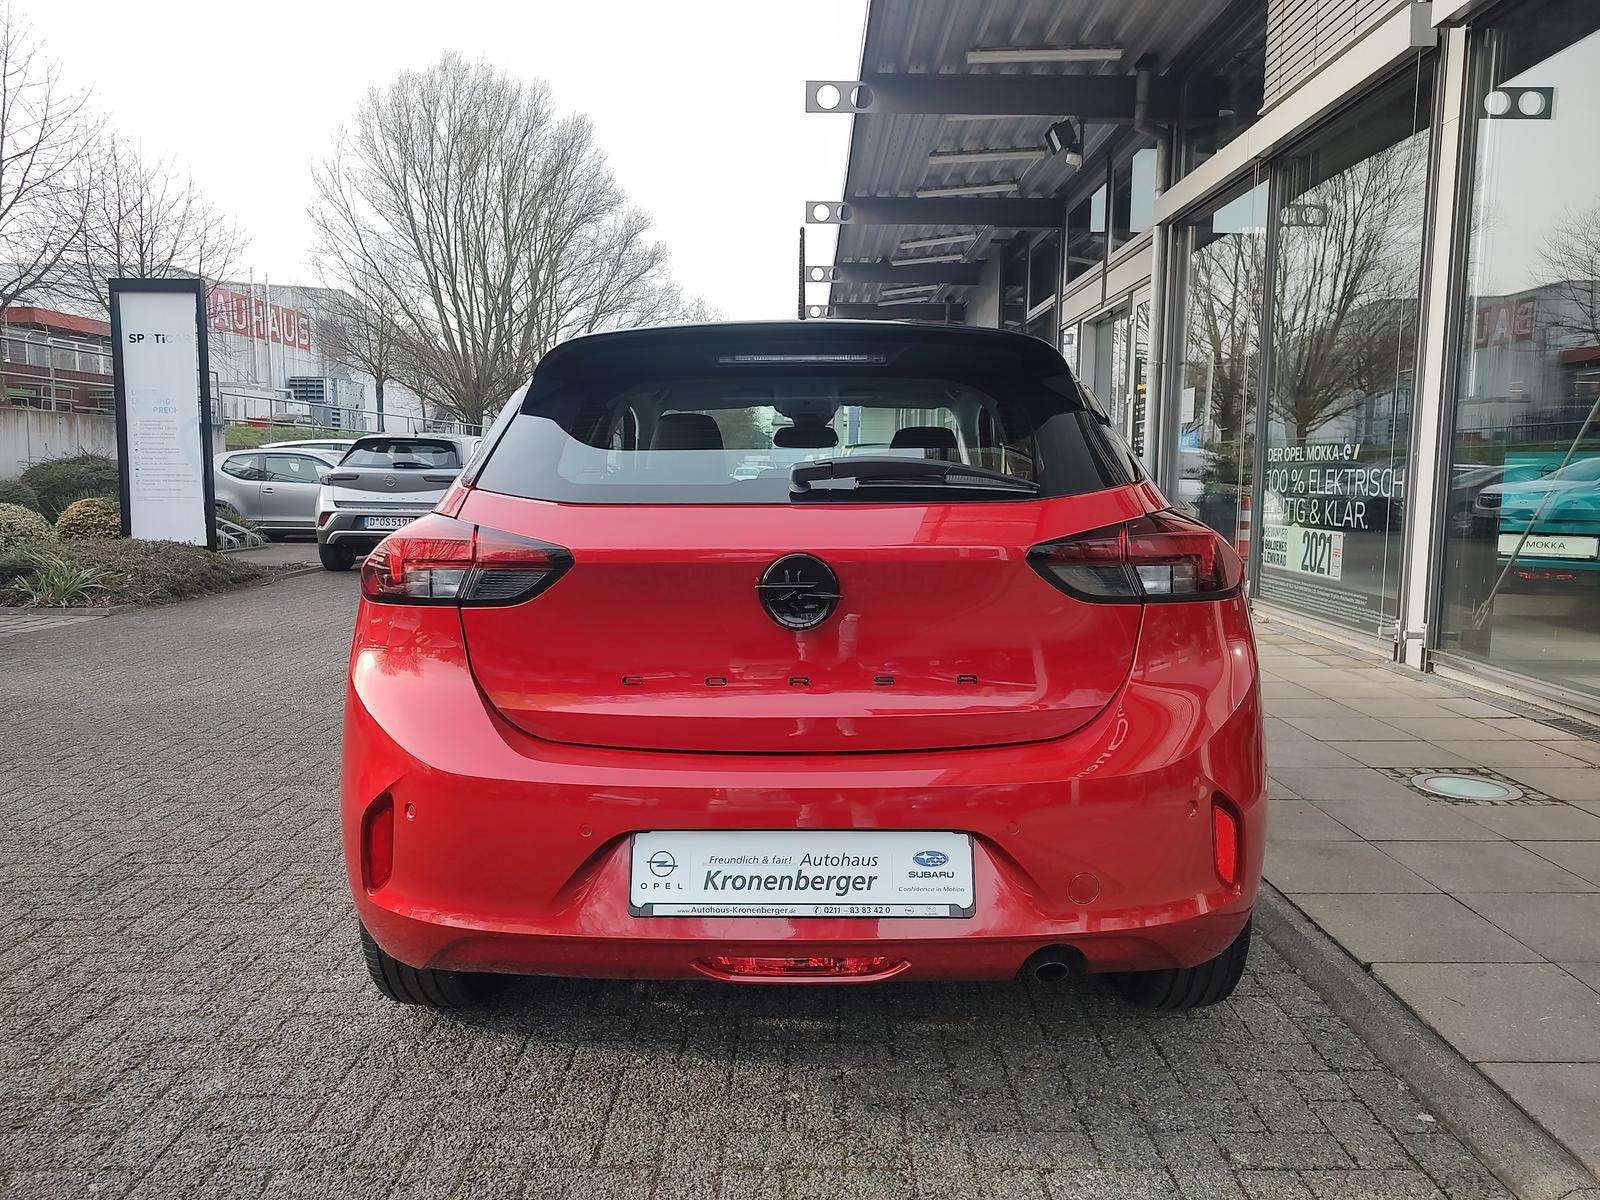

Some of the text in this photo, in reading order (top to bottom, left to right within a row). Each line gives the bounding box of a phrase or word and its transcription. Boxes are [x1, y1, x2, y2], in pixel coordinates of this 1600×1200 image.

[207, 288, 310, 349] AUHAUS
[1267, 448, 1282, 462] DER
[1284, 446, 1304, 462] OPEL
[1267, 468, 1405, 498] 100 % ELEKTRISCH
[1309, 500, 1321, 525] &
[1324, 500, 1369, 530] KLAR.
[1525, 540, 1566, 550] MOKKA
[1301, 530, 1333, 576] 2021
[622, 673, 978, 687] CORSA
[709, 852, 878, 867] Freundlich & fair! Autohaus
[908, 870, 955, 878] SUBARU
[640, 882, 683, 890] OPEL
[703, 869, 878, 897] Kronenberger
[677, 906, 797, 915] www.Autohaus-Kronenberger.de
[823, 906, 841, 914] 0211
[850, 906, 860, 914] 83
[861, 906, 871, 914] 83
[873, 906, 883, 914] 42
[885, 906, 891, 914] 0
